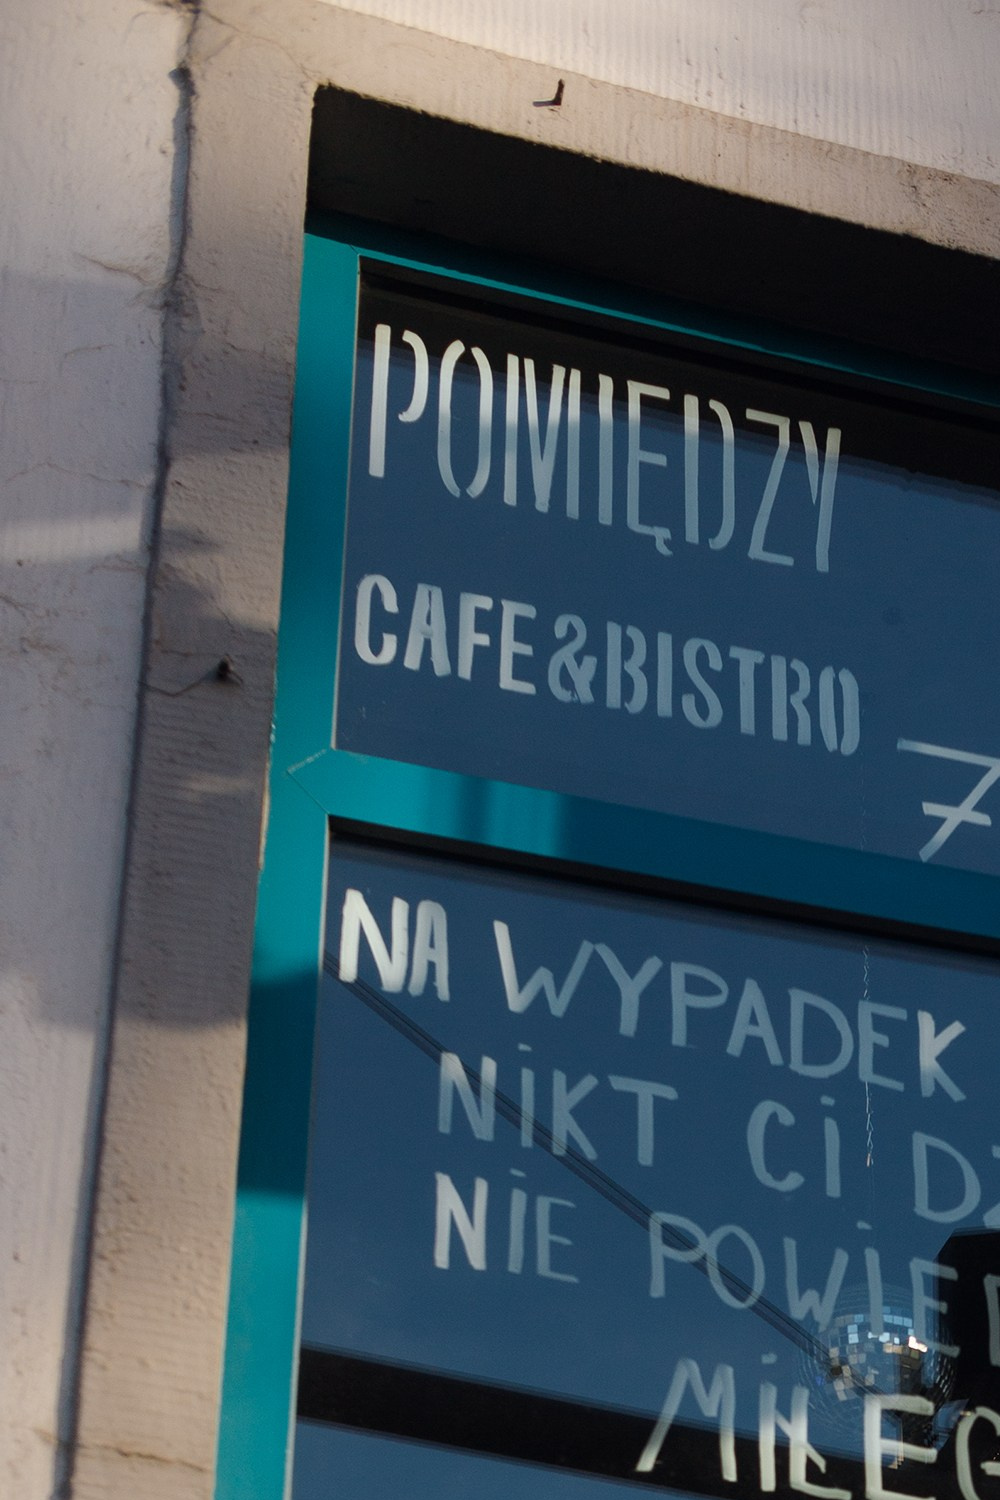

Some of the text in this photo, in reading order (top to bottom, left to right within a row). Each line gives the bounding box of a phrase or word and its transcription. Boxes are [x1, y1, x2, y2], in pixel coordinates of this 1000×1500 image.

[368, 323, 842, 573] POMIĘDZY
[353, 573, 861, 756] CAFE&BISTRO
[339, 887, 450, 1002] NA
[492, 919, 967, 1102] WYPADEK
